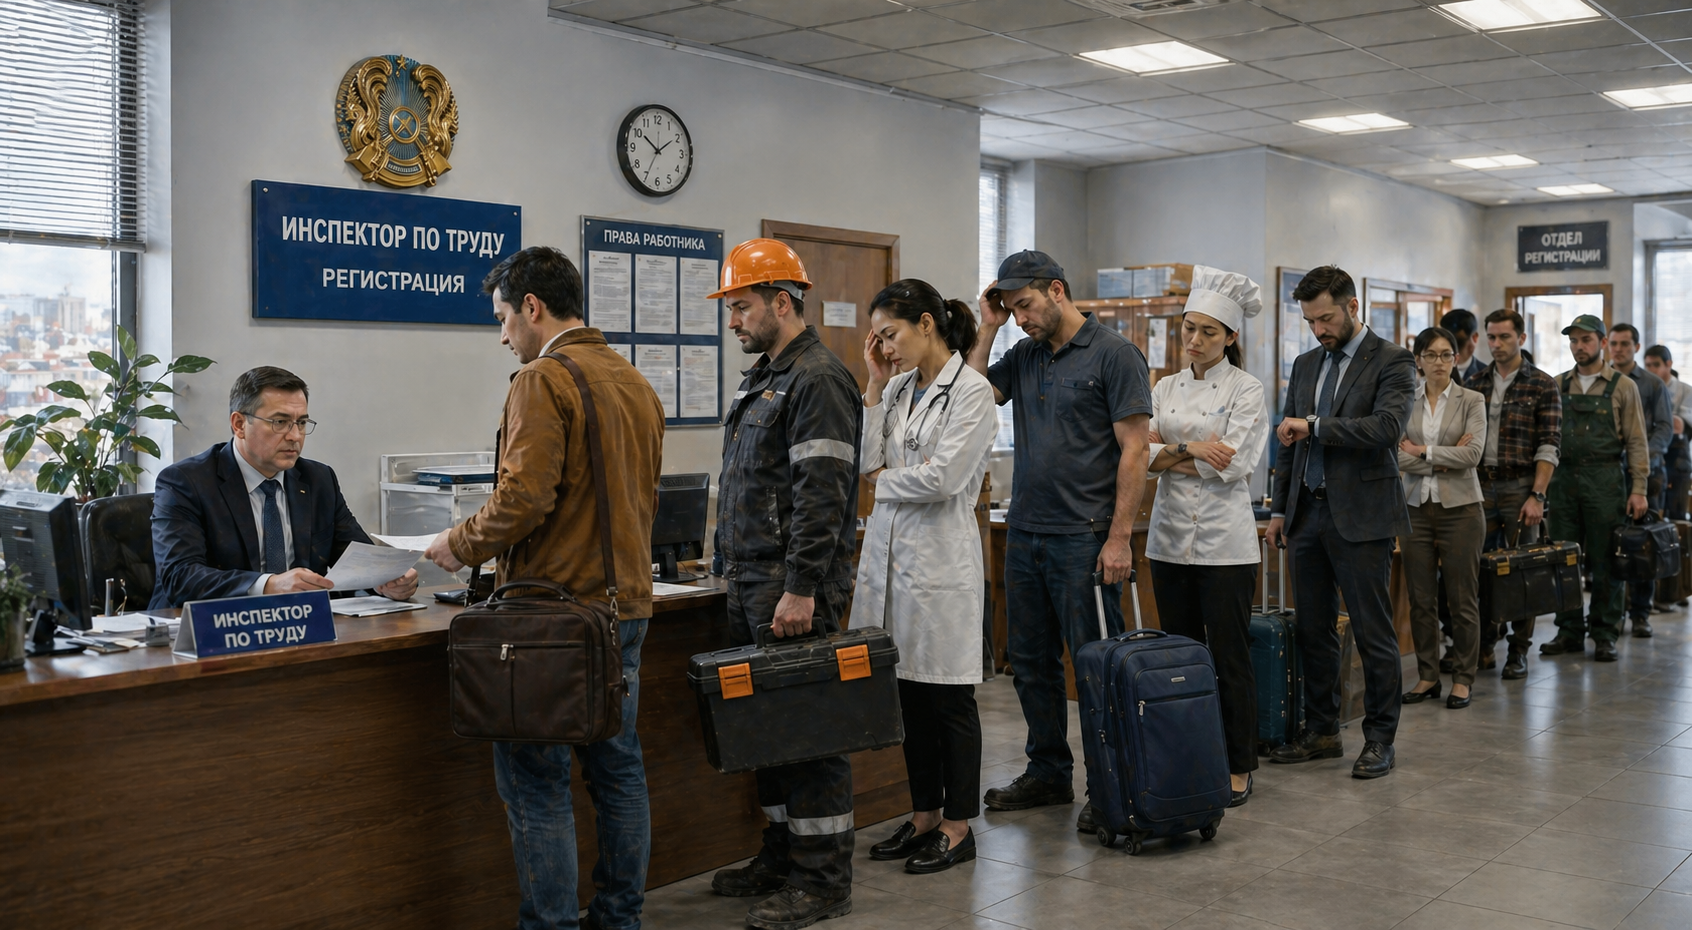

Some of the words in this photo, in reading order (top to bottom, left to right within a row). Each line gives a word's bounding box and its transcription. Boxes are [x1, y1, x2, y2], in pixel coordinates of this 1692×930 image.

[642, 118, 650, 128] 11
[653, 115, 662, 125] 12
[667, 121, 671, 131] 1
[633, 127, 643, 138] 10
[675, 133, 681, 144] 2
[630, 142, 636, 152] 9
[679, 149, 685, 159] 3
[634, 159, 640, 169] 8
[675, 164, 680, 174] 4
[643, 171, 650, 182] 7
[654, 176, 661, 187] 6
[666, 174, 672, 184] 5
[282, 215, 407, 249] ИНСПЕКТОР
[413, 226, 441, 251] ПО
[445, 229, 505, 258] ТРУДУ
[604, 229, 640, 245] ПРАВА
[643, 234, 705, 250] РАБОТНИКА
[1541, 231, 1583, 248] ОТДЕЛ
[1524, 249, 1601, 264] РЕГИСТРАЦИИ
[322, 268, 465, 296] РЕГИСТРАЦИЯ
[213, 604, 313, 628] ИНСПЕКТОР
[224, 633, 251, 648] ПО
[253, 625, 307, 644] ТРУДУ
